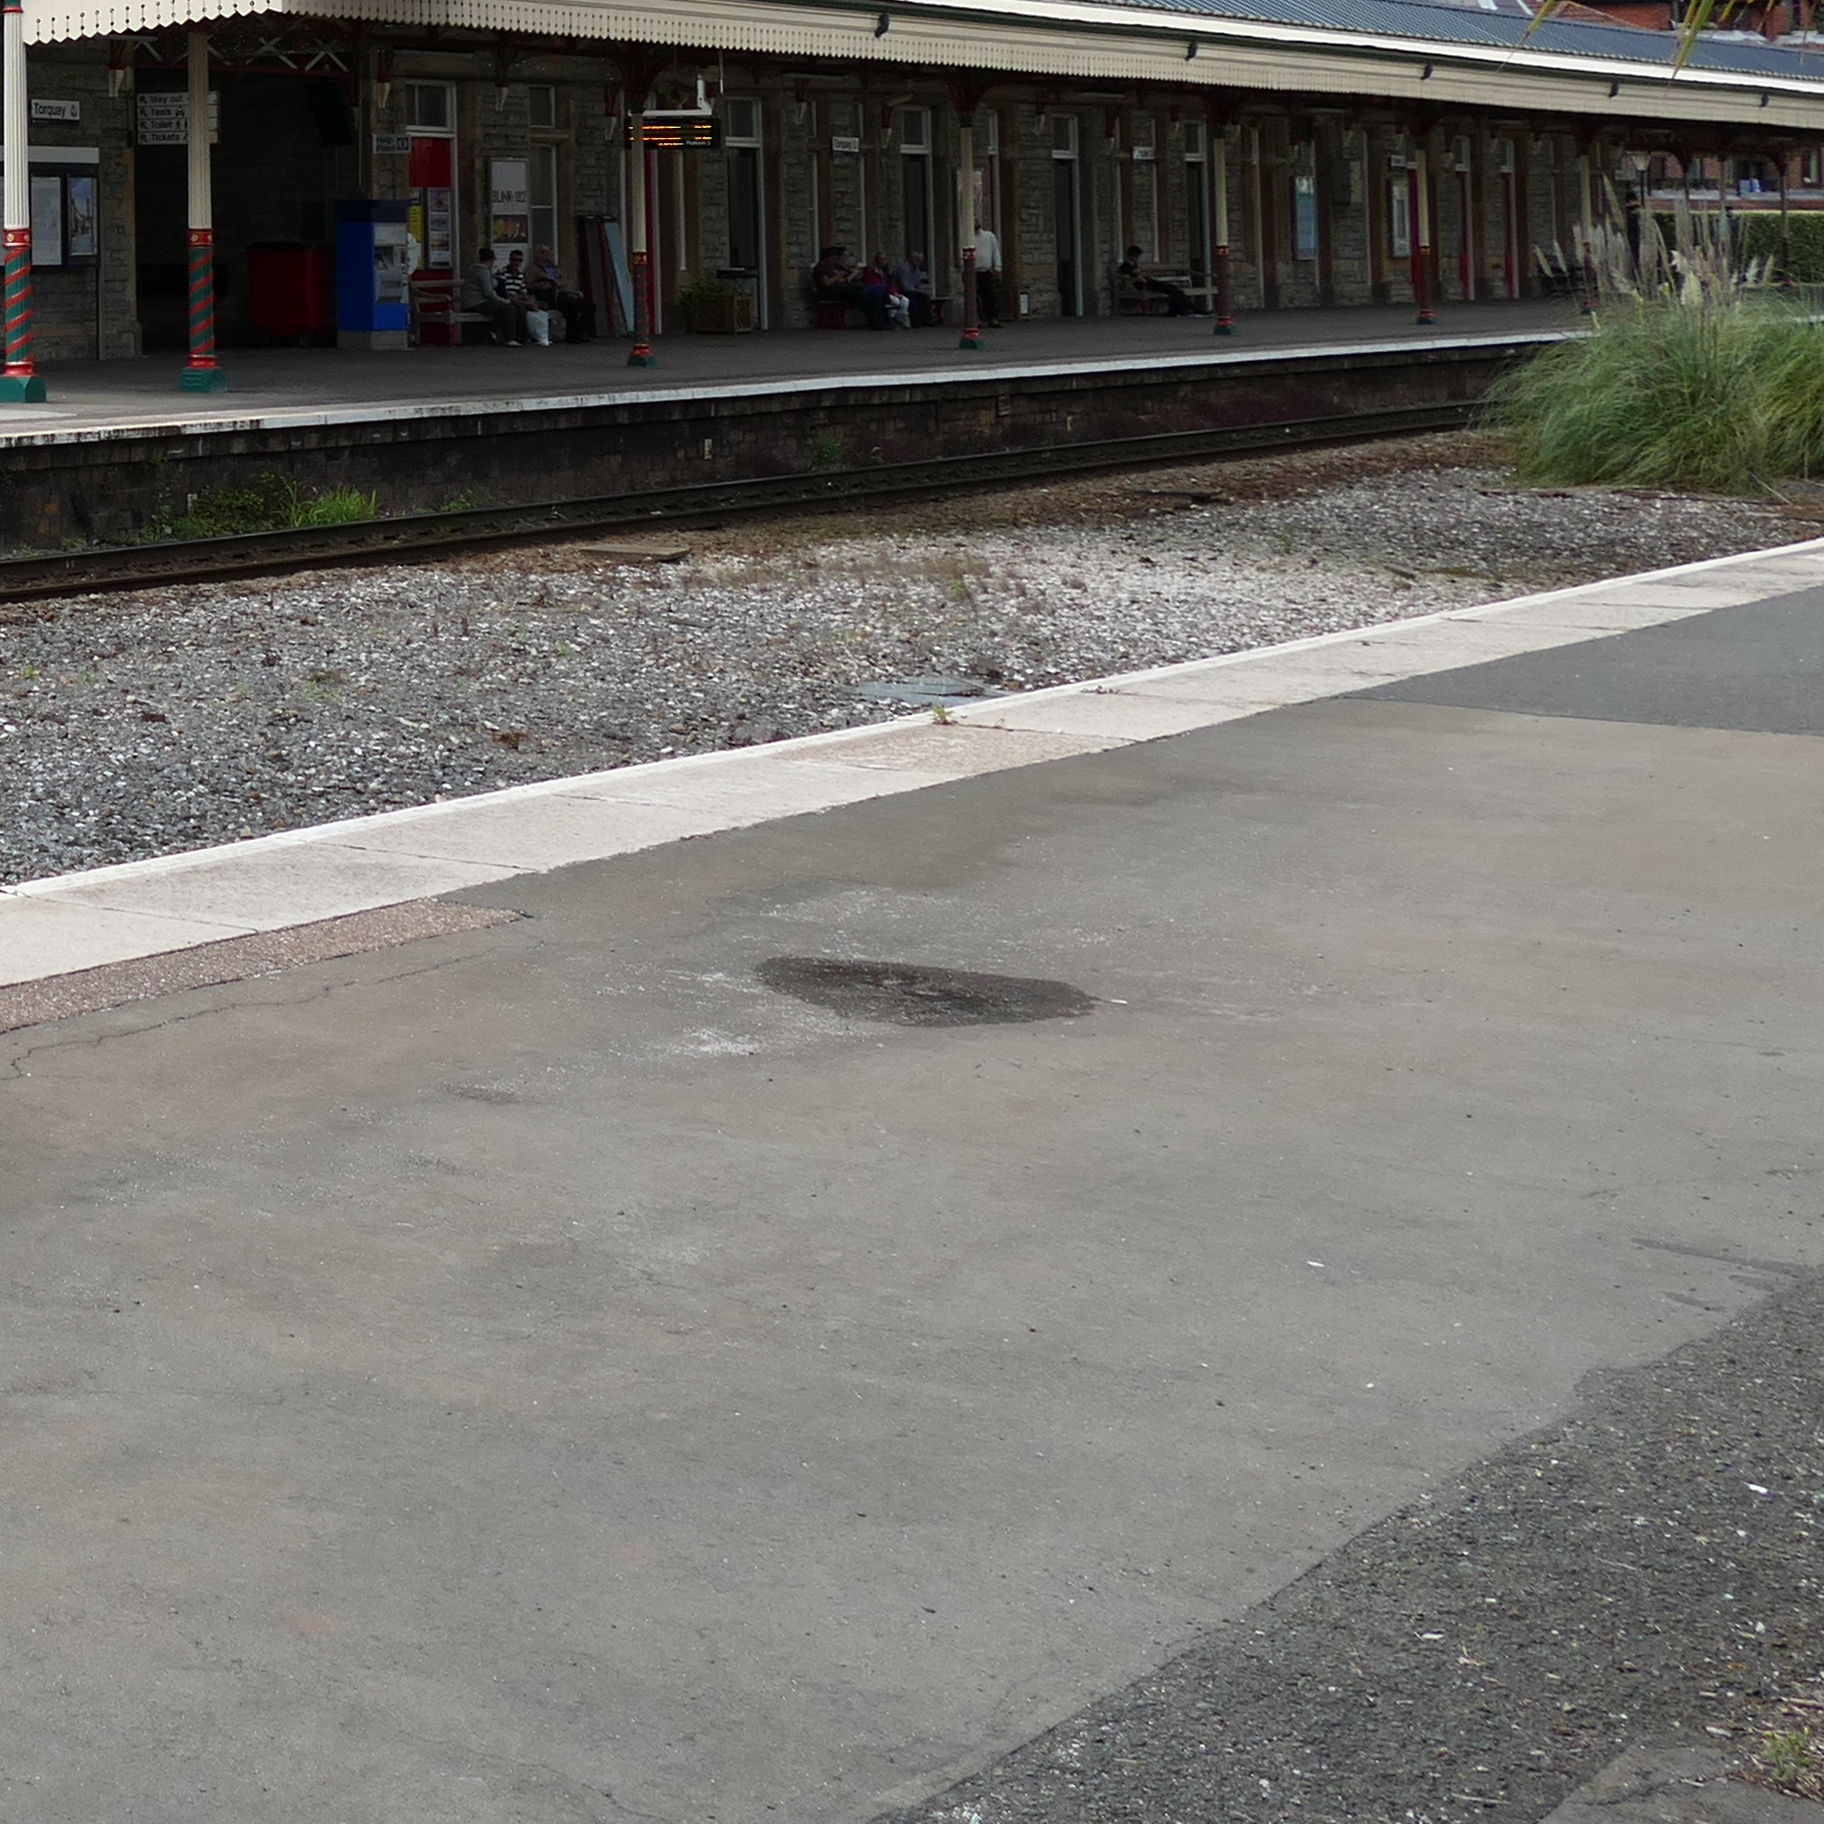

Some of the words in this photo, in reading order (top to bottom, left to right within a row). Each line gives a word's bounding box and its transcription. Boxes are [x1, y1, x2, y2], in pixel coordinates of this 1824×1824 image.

[149, 95, 167, 104] Way
[169, 95, 184, 103] out
[34, 102, 66, 118] Torquay
[150, 107, 172, 116] Taxis
[151, 133, 180, 142] Tickets
